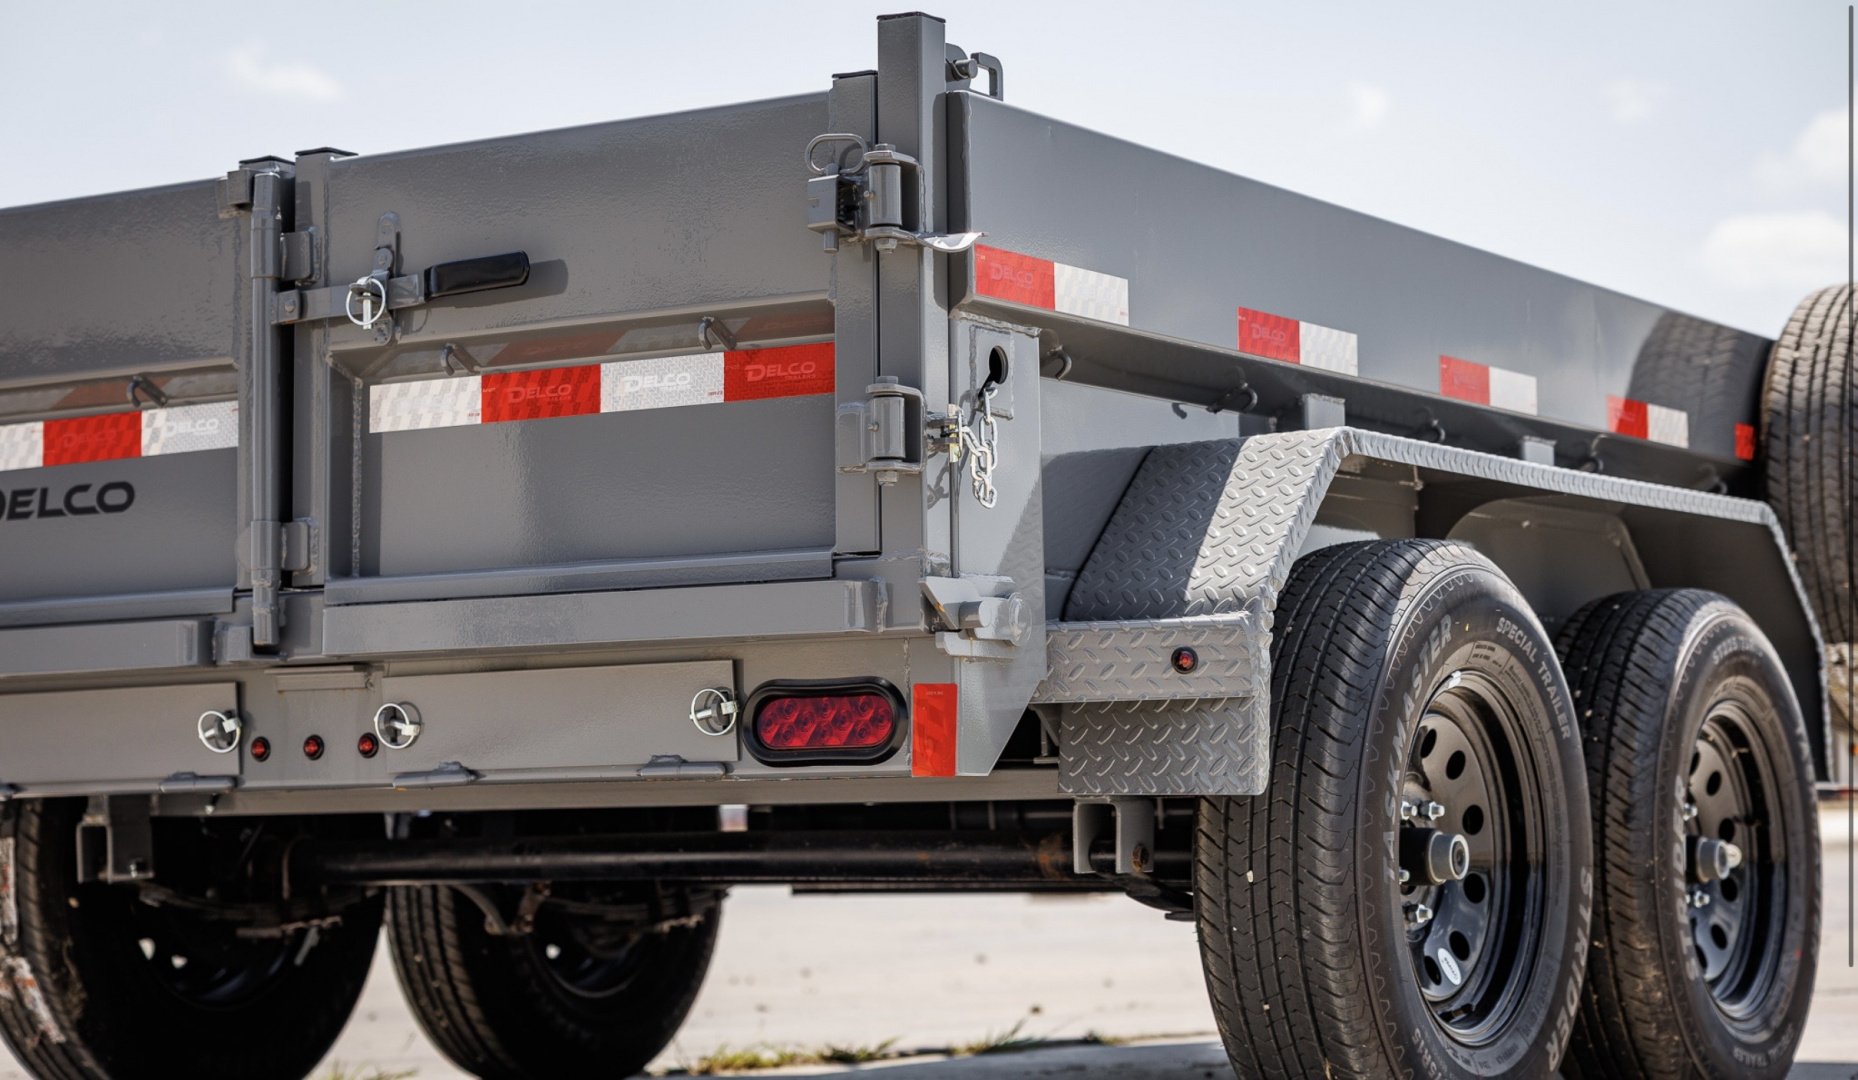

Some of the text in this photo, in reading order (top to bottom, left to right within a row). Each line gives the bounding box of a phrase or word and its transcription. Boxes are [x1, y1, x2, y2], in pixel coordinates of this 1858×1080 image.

[988, 259, 1035, 286] DELCO
[619, 371, 691, 393] DELCO
[744, 360, 817, 383] DELCO
[507, 382, 573, 404] DELCO
[163, 416, 220, 439] DELCO
[1495, 616, 1540, 664] SPECIAL
[1536, 659, 1573, 740] TRAILER
[1383, 613, 1454, 884] TASKMASTER
[1672, 774, 1701, 982] STRIDER
[1545, 865, 1593, 1073] STRIDER
